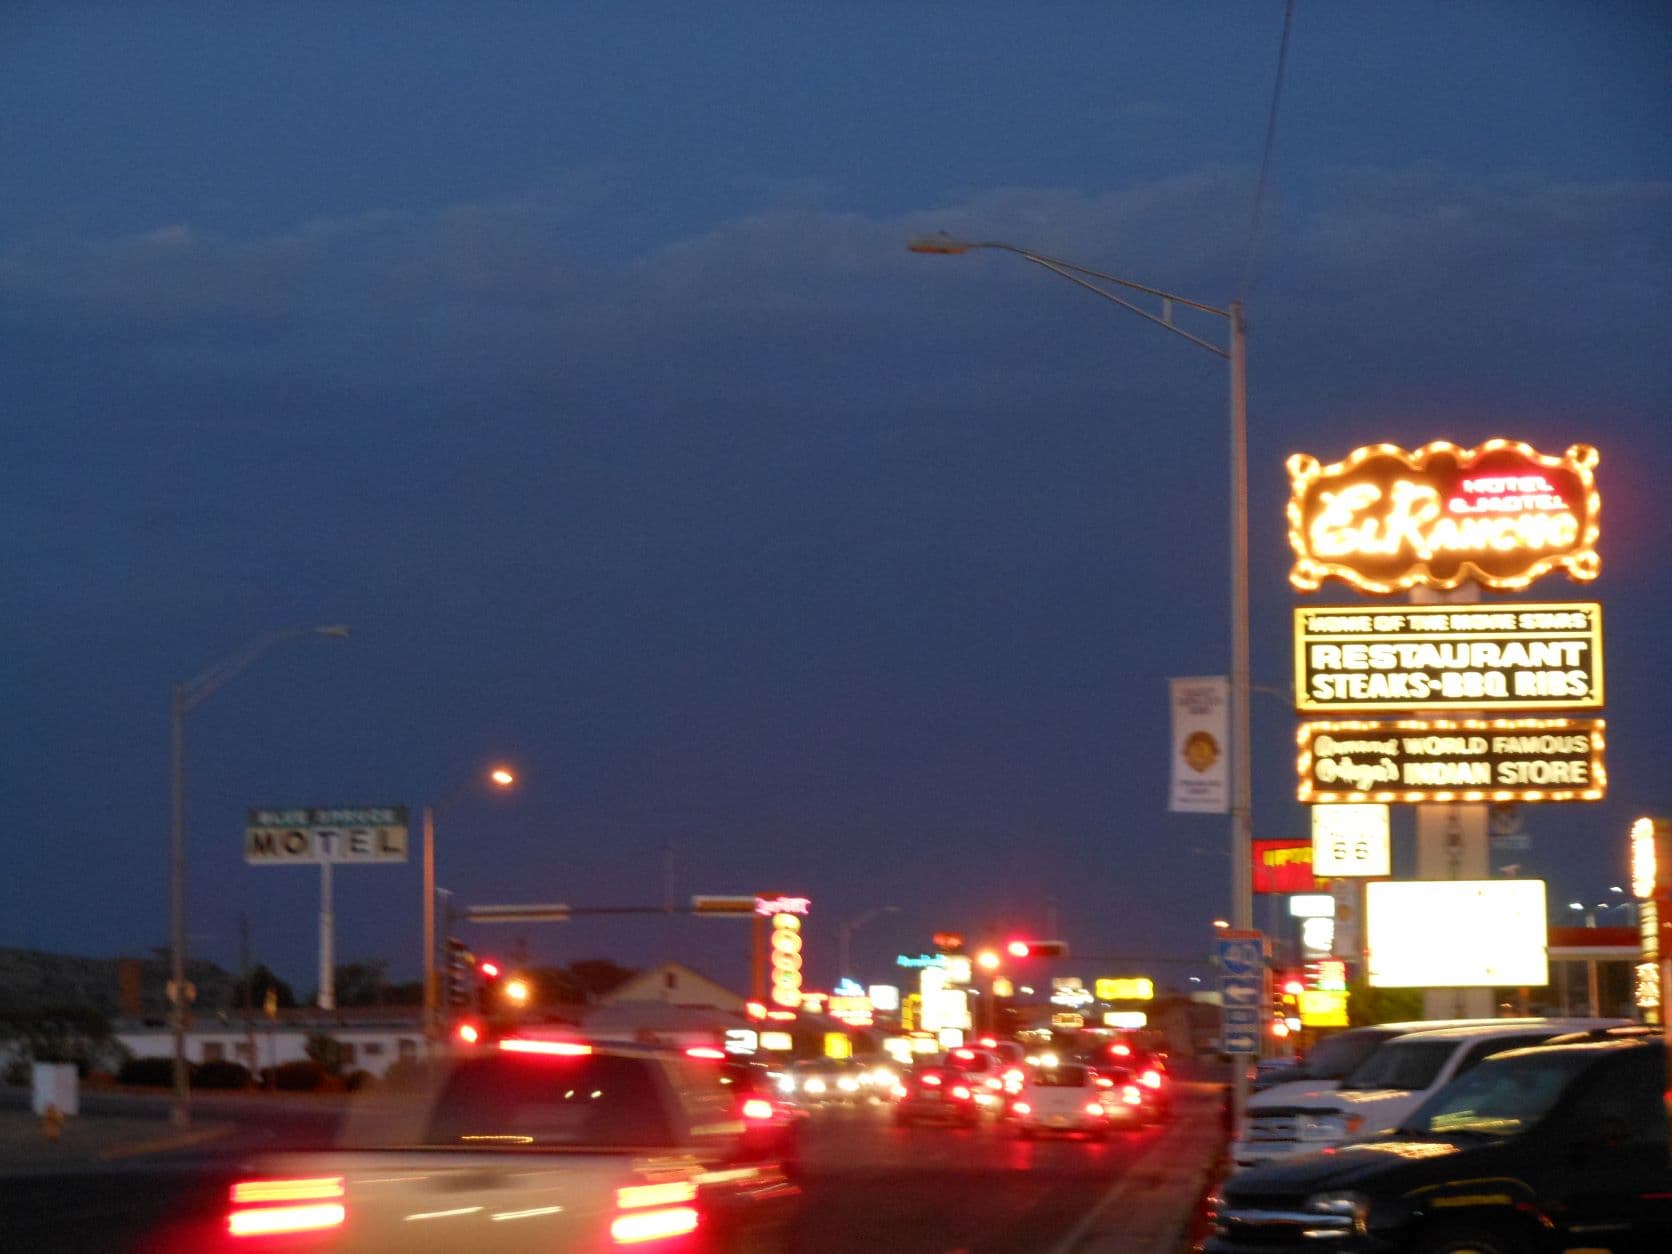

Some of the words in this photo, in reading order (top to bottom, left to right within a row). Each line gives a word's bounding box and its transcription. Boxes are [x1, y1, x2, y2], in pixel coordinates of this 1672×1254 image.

[1311, 642, 1588, 669] RESTAURANT
[1514, 670, 1589, 697] RIBS
[1402, 736, 1488, 755] WORLD
[1493, 735, 1589, 754] FAMOUS
[1403, 762, 1491, 785] INDIAN
[1498, 761, 1588, 784] STORE
[253, 831, 402, 855] MOTEL
